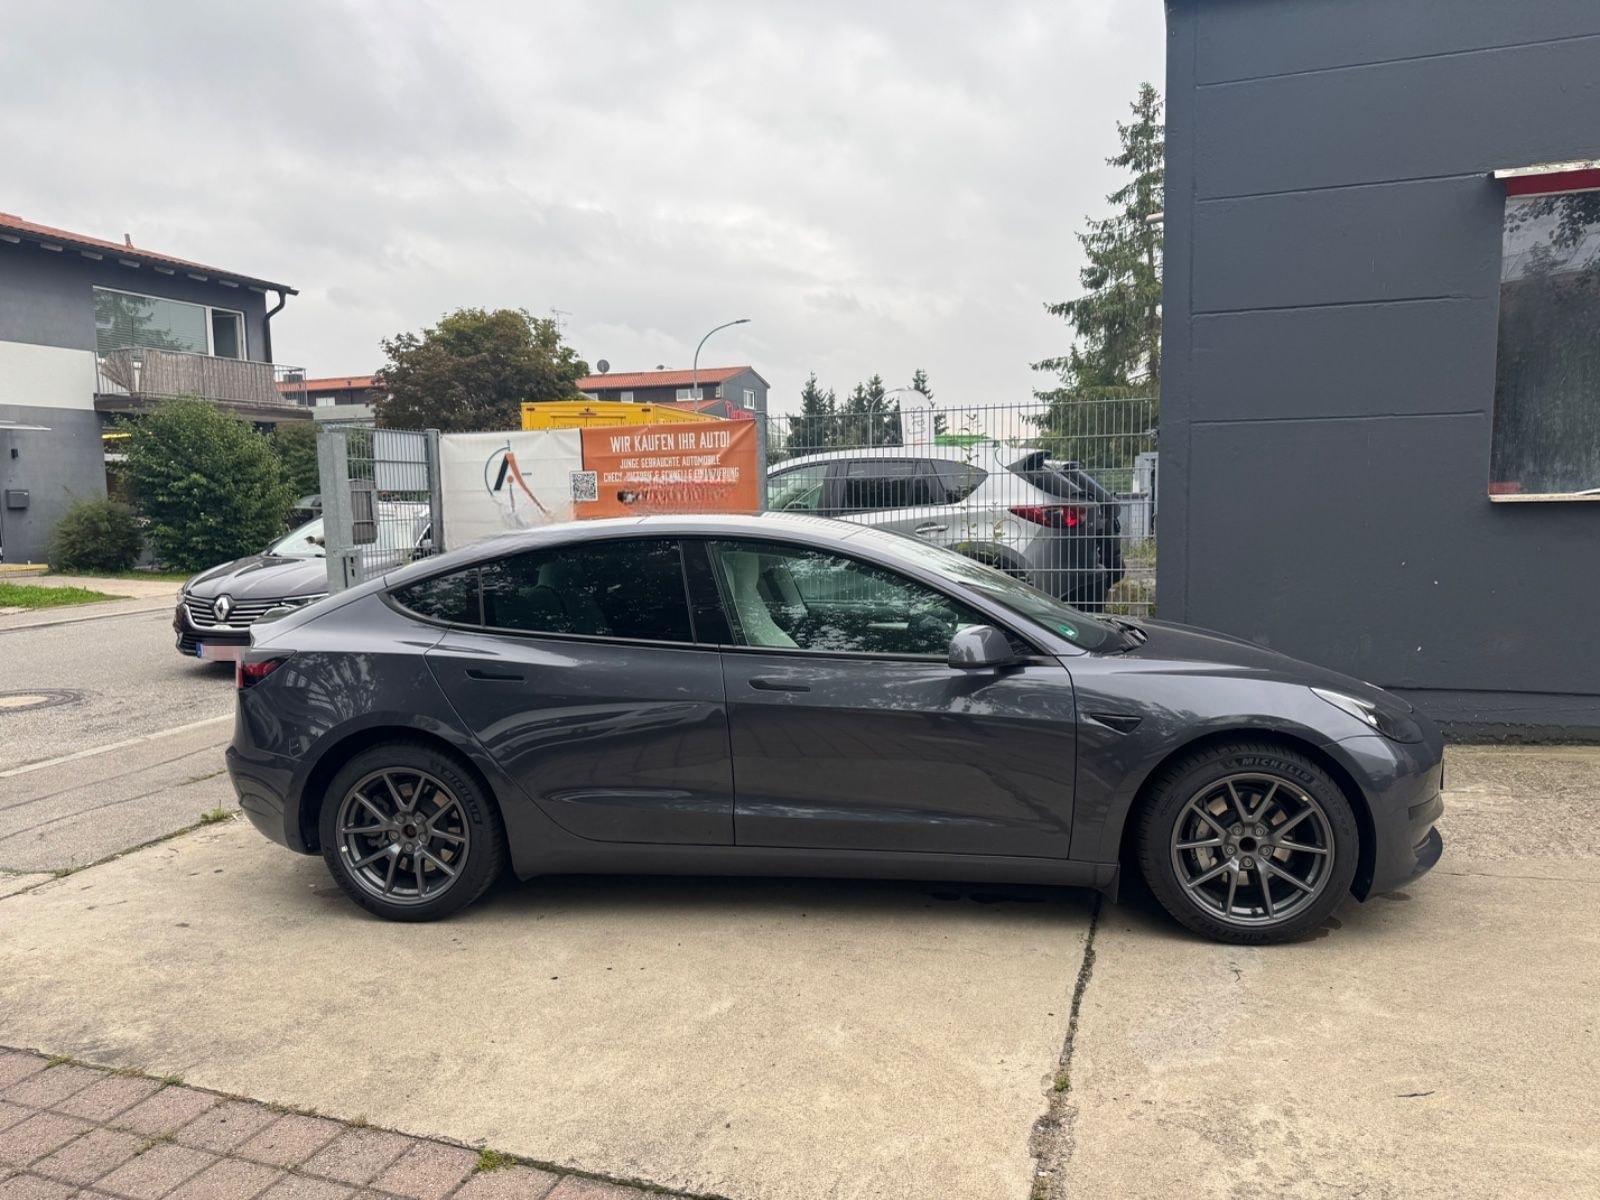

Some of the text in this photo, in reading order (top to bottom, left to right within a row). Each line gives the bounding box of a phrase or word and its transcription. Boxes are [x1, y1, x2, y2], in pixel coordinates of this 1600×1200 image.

[610, 435, 631, 453] WIR
[634, 433, 674, 452] KAUFEN
[679, 432, 696, 450] IHR
[1242, 757, 1313, 782] MICHELIN
